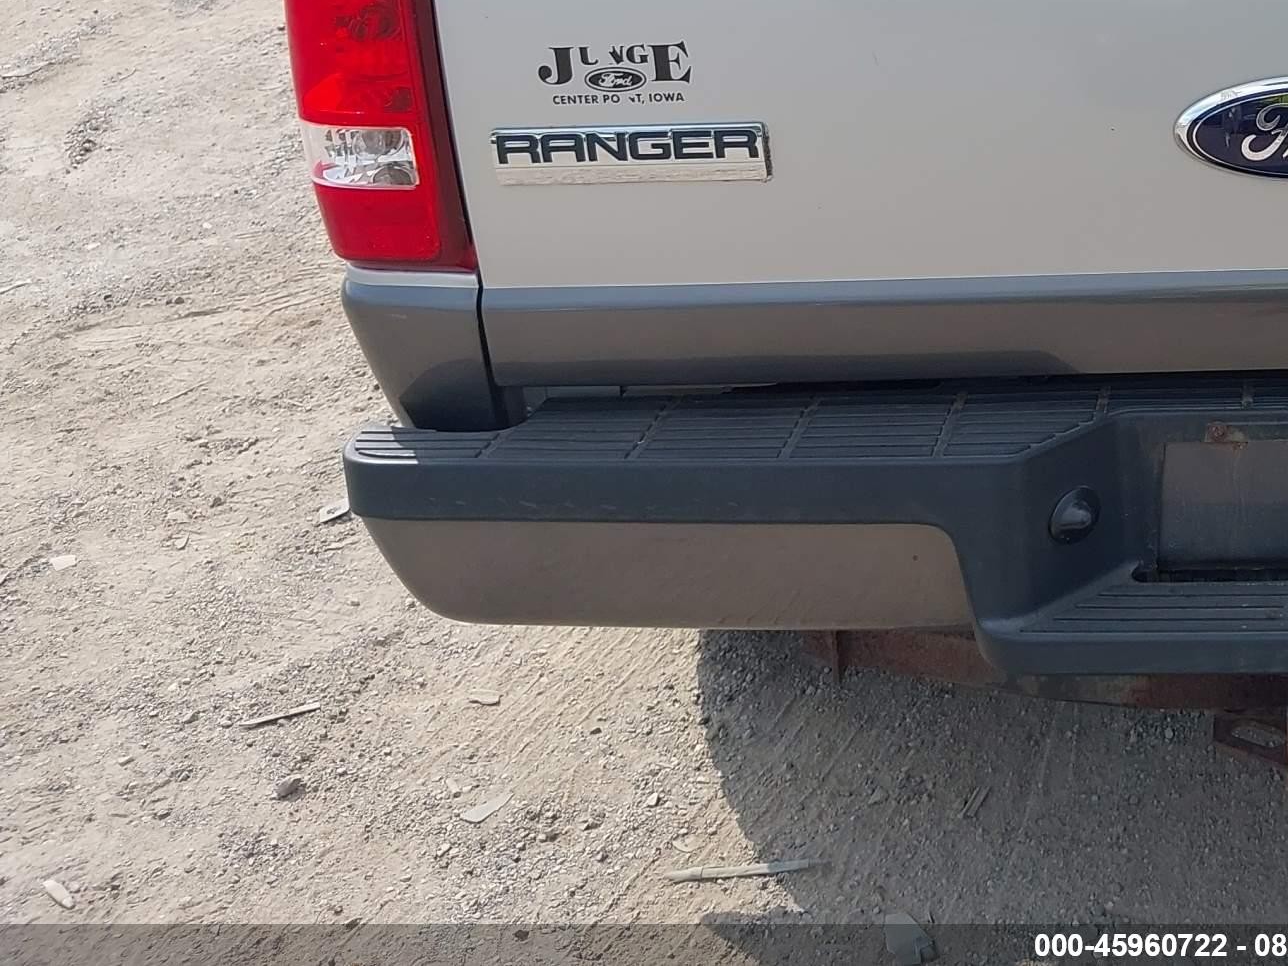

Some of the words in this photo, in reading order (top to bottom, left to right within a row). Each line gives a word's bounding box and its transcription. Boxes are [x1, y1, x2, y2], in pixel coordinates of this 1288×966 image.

[598, 72, 633, 87] Ford
[552, 94, 599, 105] CENTER
[603, 93, 645, 105] POT,
[649, 92, 685, 102] IOWA
[495, 129, 760, 165] RANGER
